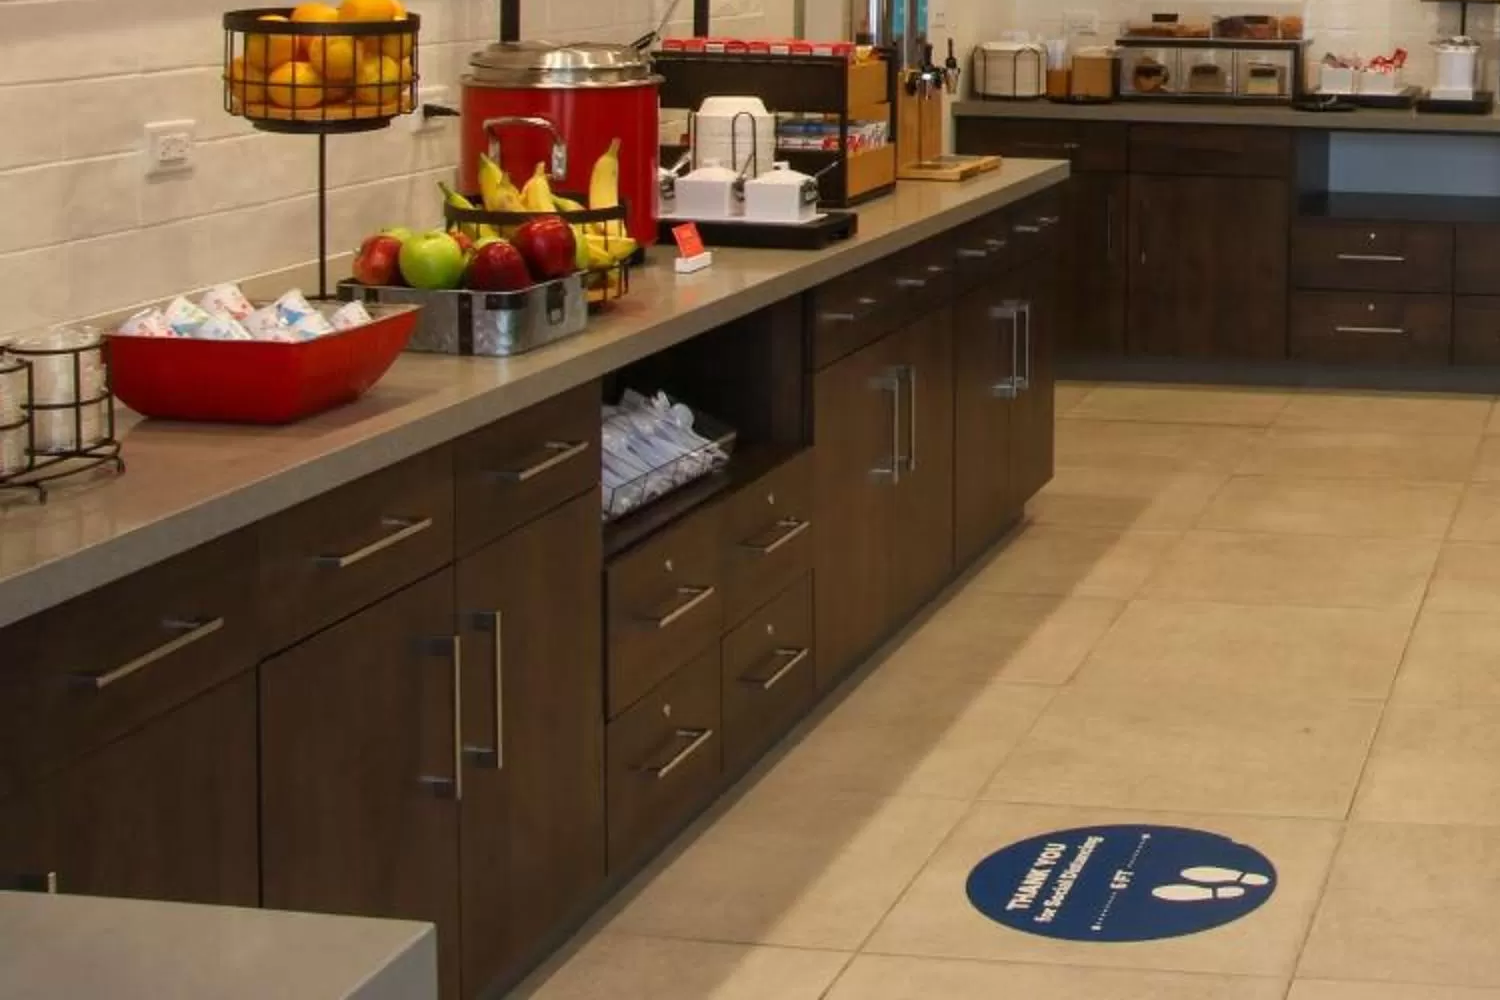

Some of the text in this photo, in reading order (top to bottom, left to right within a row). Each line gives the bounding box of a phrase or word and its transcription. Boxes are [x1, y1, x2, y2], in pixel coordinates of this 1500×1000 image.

[1005, 843, 1067, 911] THANK YOU
[1043, 878, 1075, 907] Social
